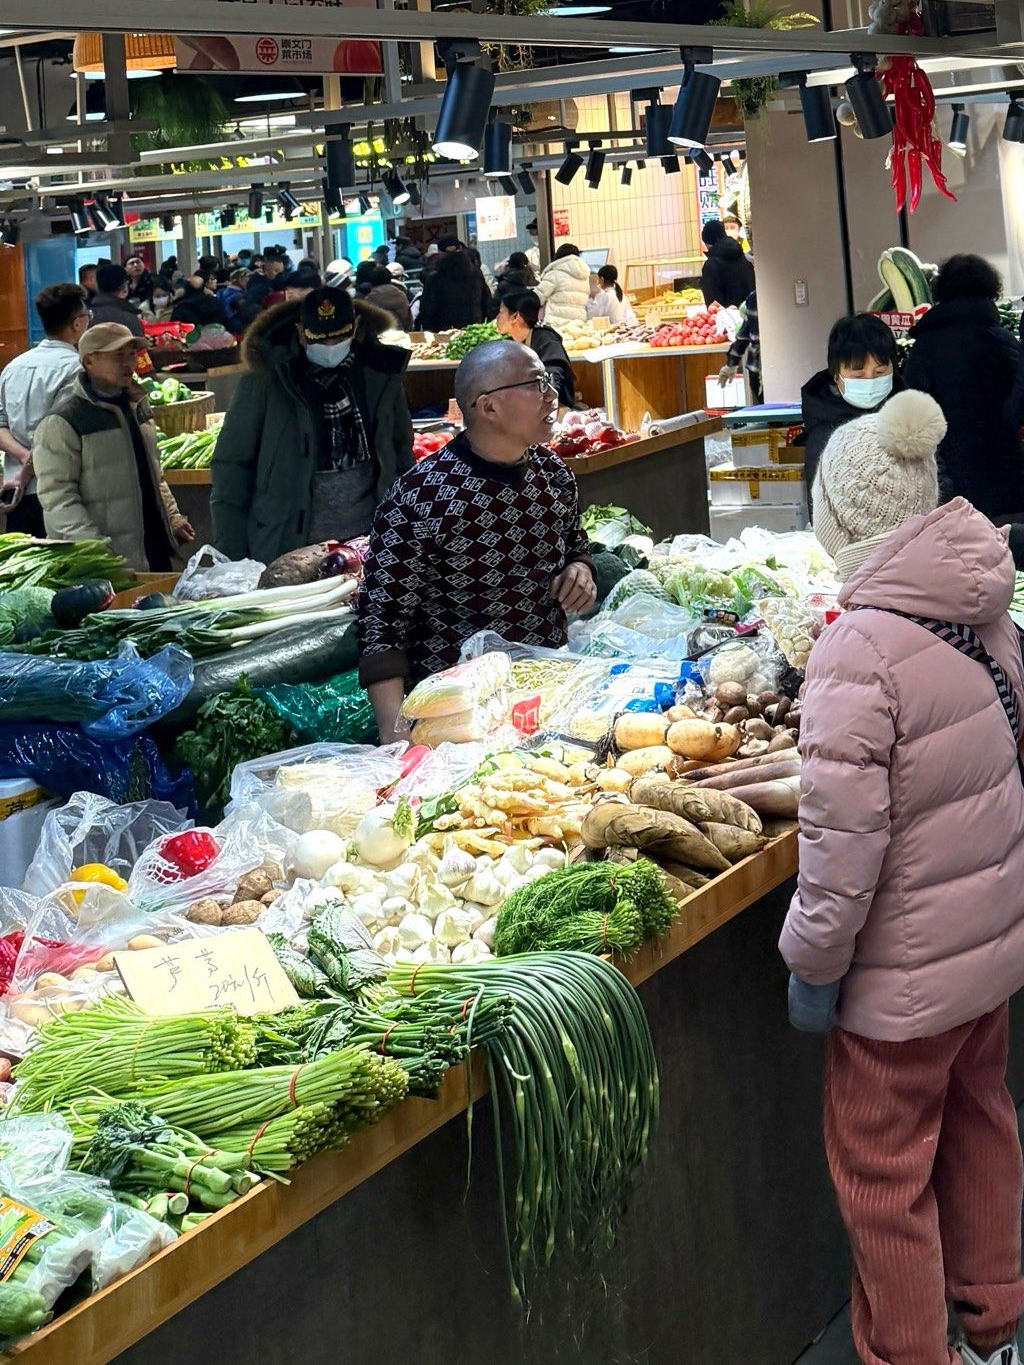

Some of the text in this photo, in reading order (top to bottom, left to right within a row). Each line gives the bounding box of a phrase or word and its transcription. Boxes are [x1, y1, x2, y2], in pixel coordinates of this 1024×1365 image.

[281, 38, 312, 50] 崇文门
[281, 49, 313, 61] 菜市场
